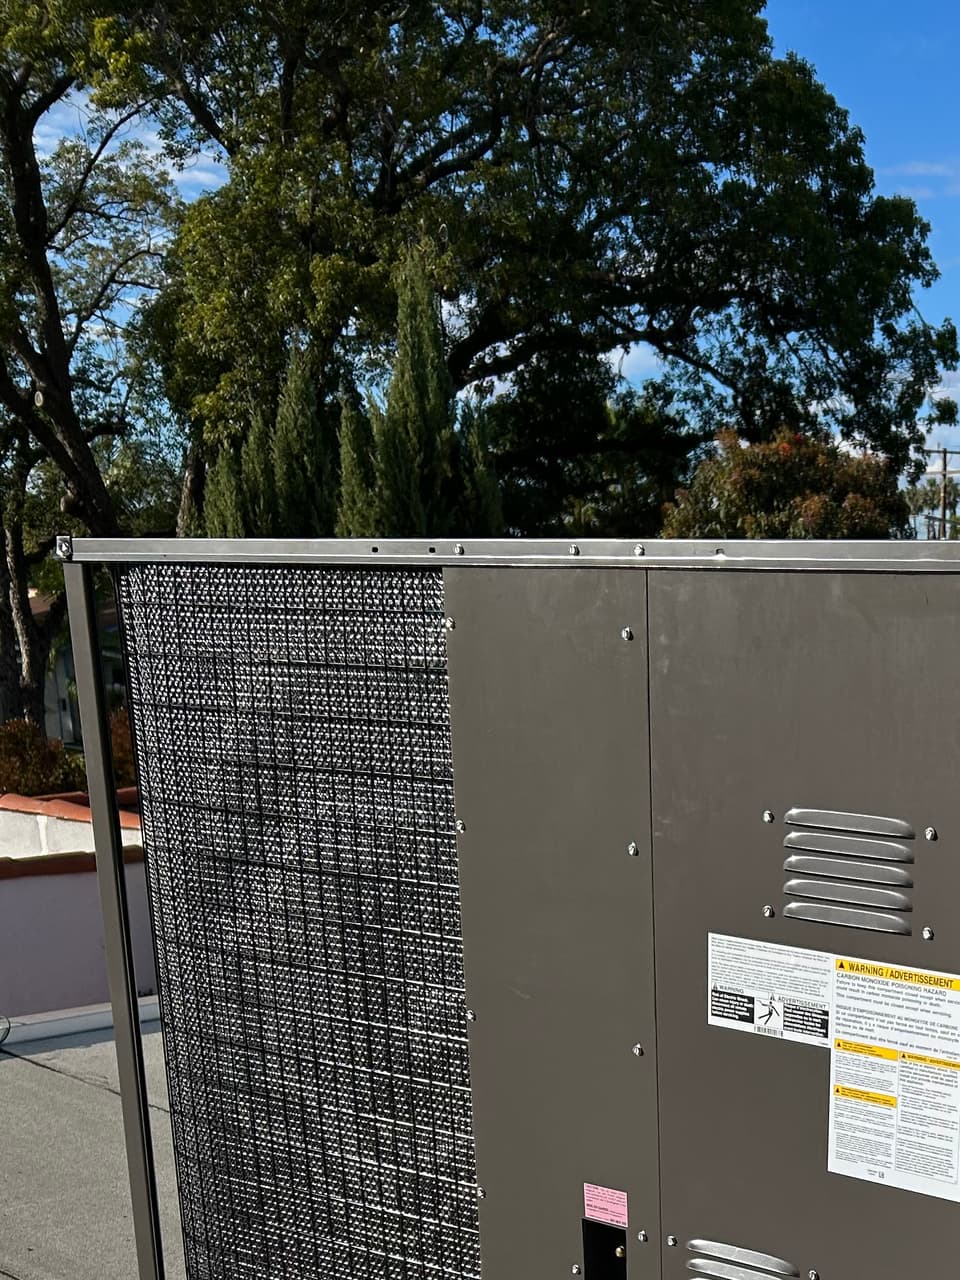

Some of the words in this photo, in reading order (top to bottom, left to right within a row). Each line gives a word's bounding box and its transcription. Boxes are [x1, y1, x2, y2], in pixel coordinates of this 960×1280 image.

[837, 973, 860, 981] CARBON
[861, 977, 889, 986] MONOXIDE
[891, 982, 922, 992] POISONING
[923, 988, 947, 997] HAZARD
[849, 963, 883, 977] WARNING
[885, 969, 888, 977] /
[890, 970, 954, 989] ADVERTISSEMENT
